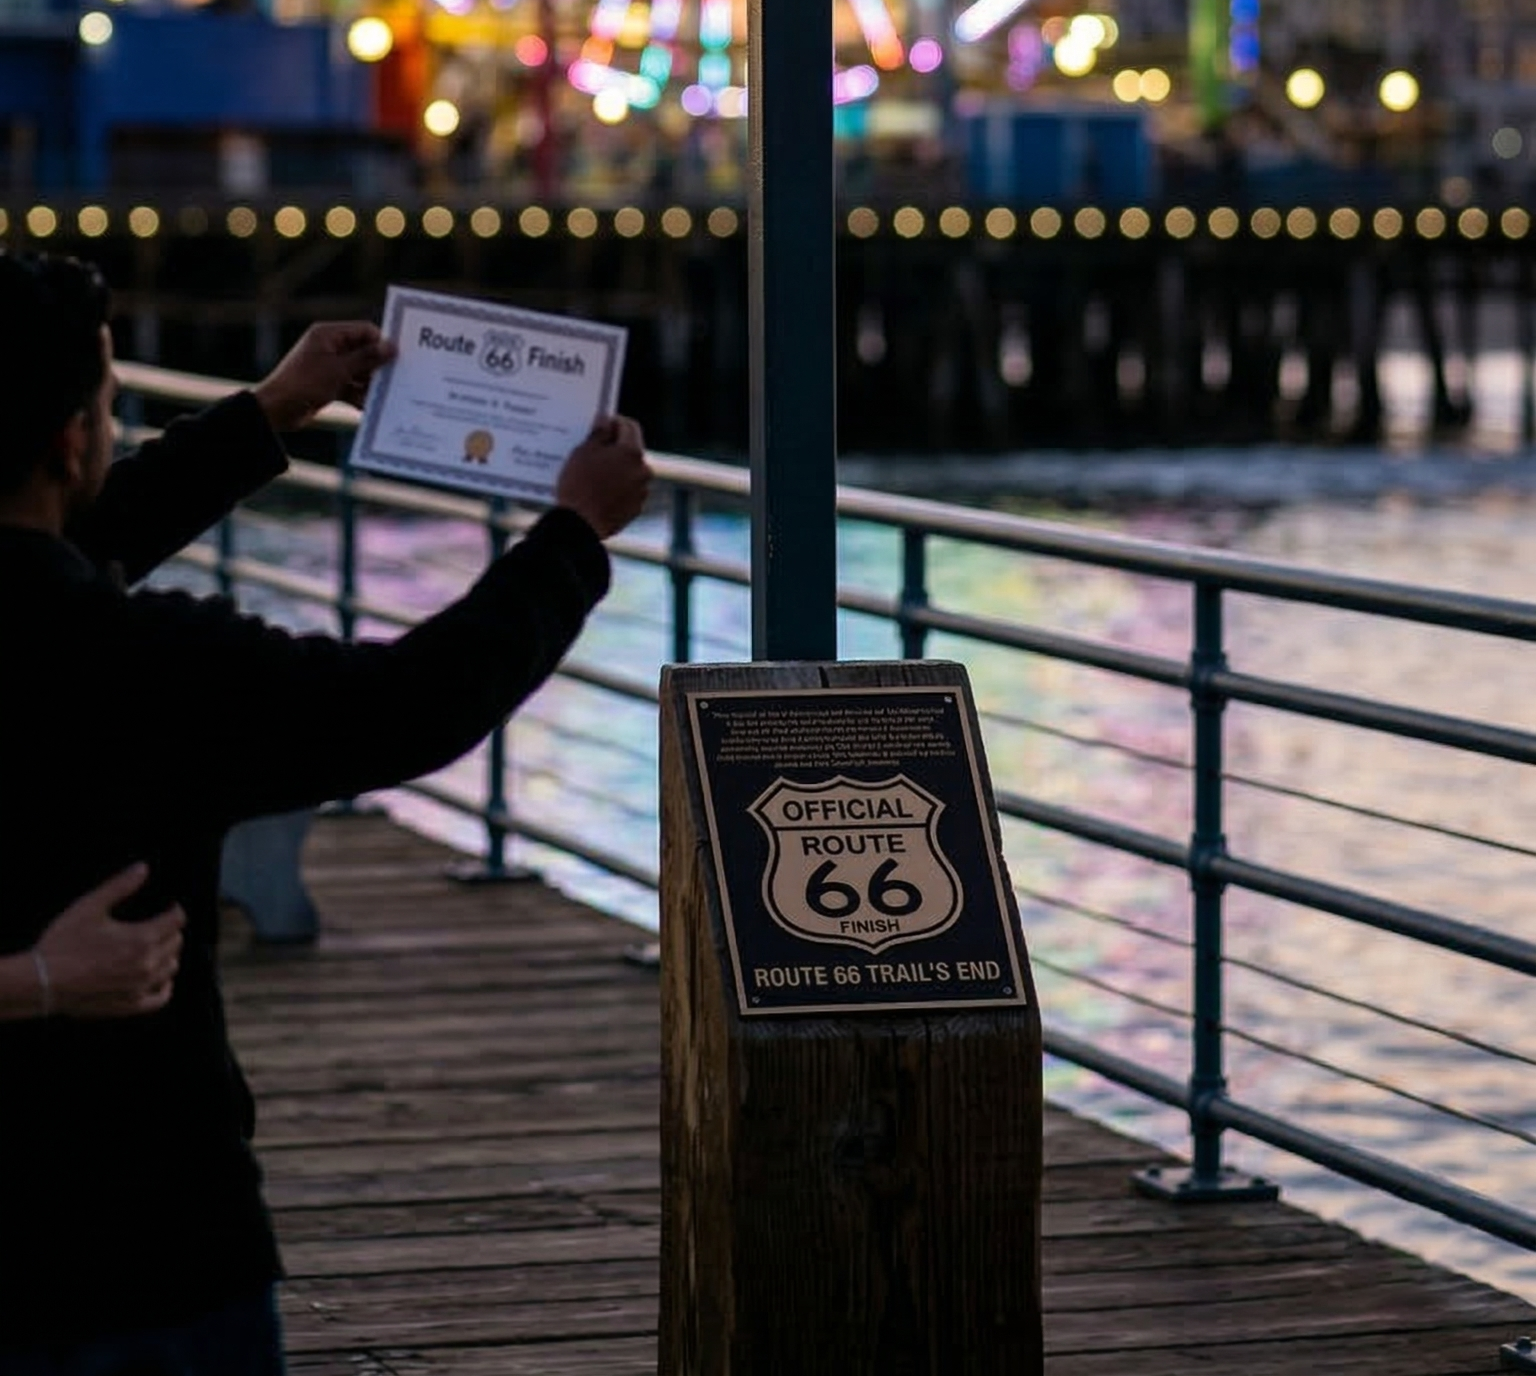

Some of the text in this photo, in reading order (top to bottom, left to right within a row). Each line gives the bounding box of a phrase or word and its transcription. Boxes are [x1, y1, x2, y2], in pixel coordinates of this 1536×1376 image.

[418, 326, 477, 356] Route
[485, 351, 515, 371] 66
[527, 346, 586, 375] Finish
[782, 797, 914, 822] OFFICIAL
[801, 833, 906, 856] ROUTE
[805, 857, 923, 919] 66
[839, 918, 900, 934] FINISH
[754, 960, 1001, 988] ROUTE 66 TRAIL'S END
